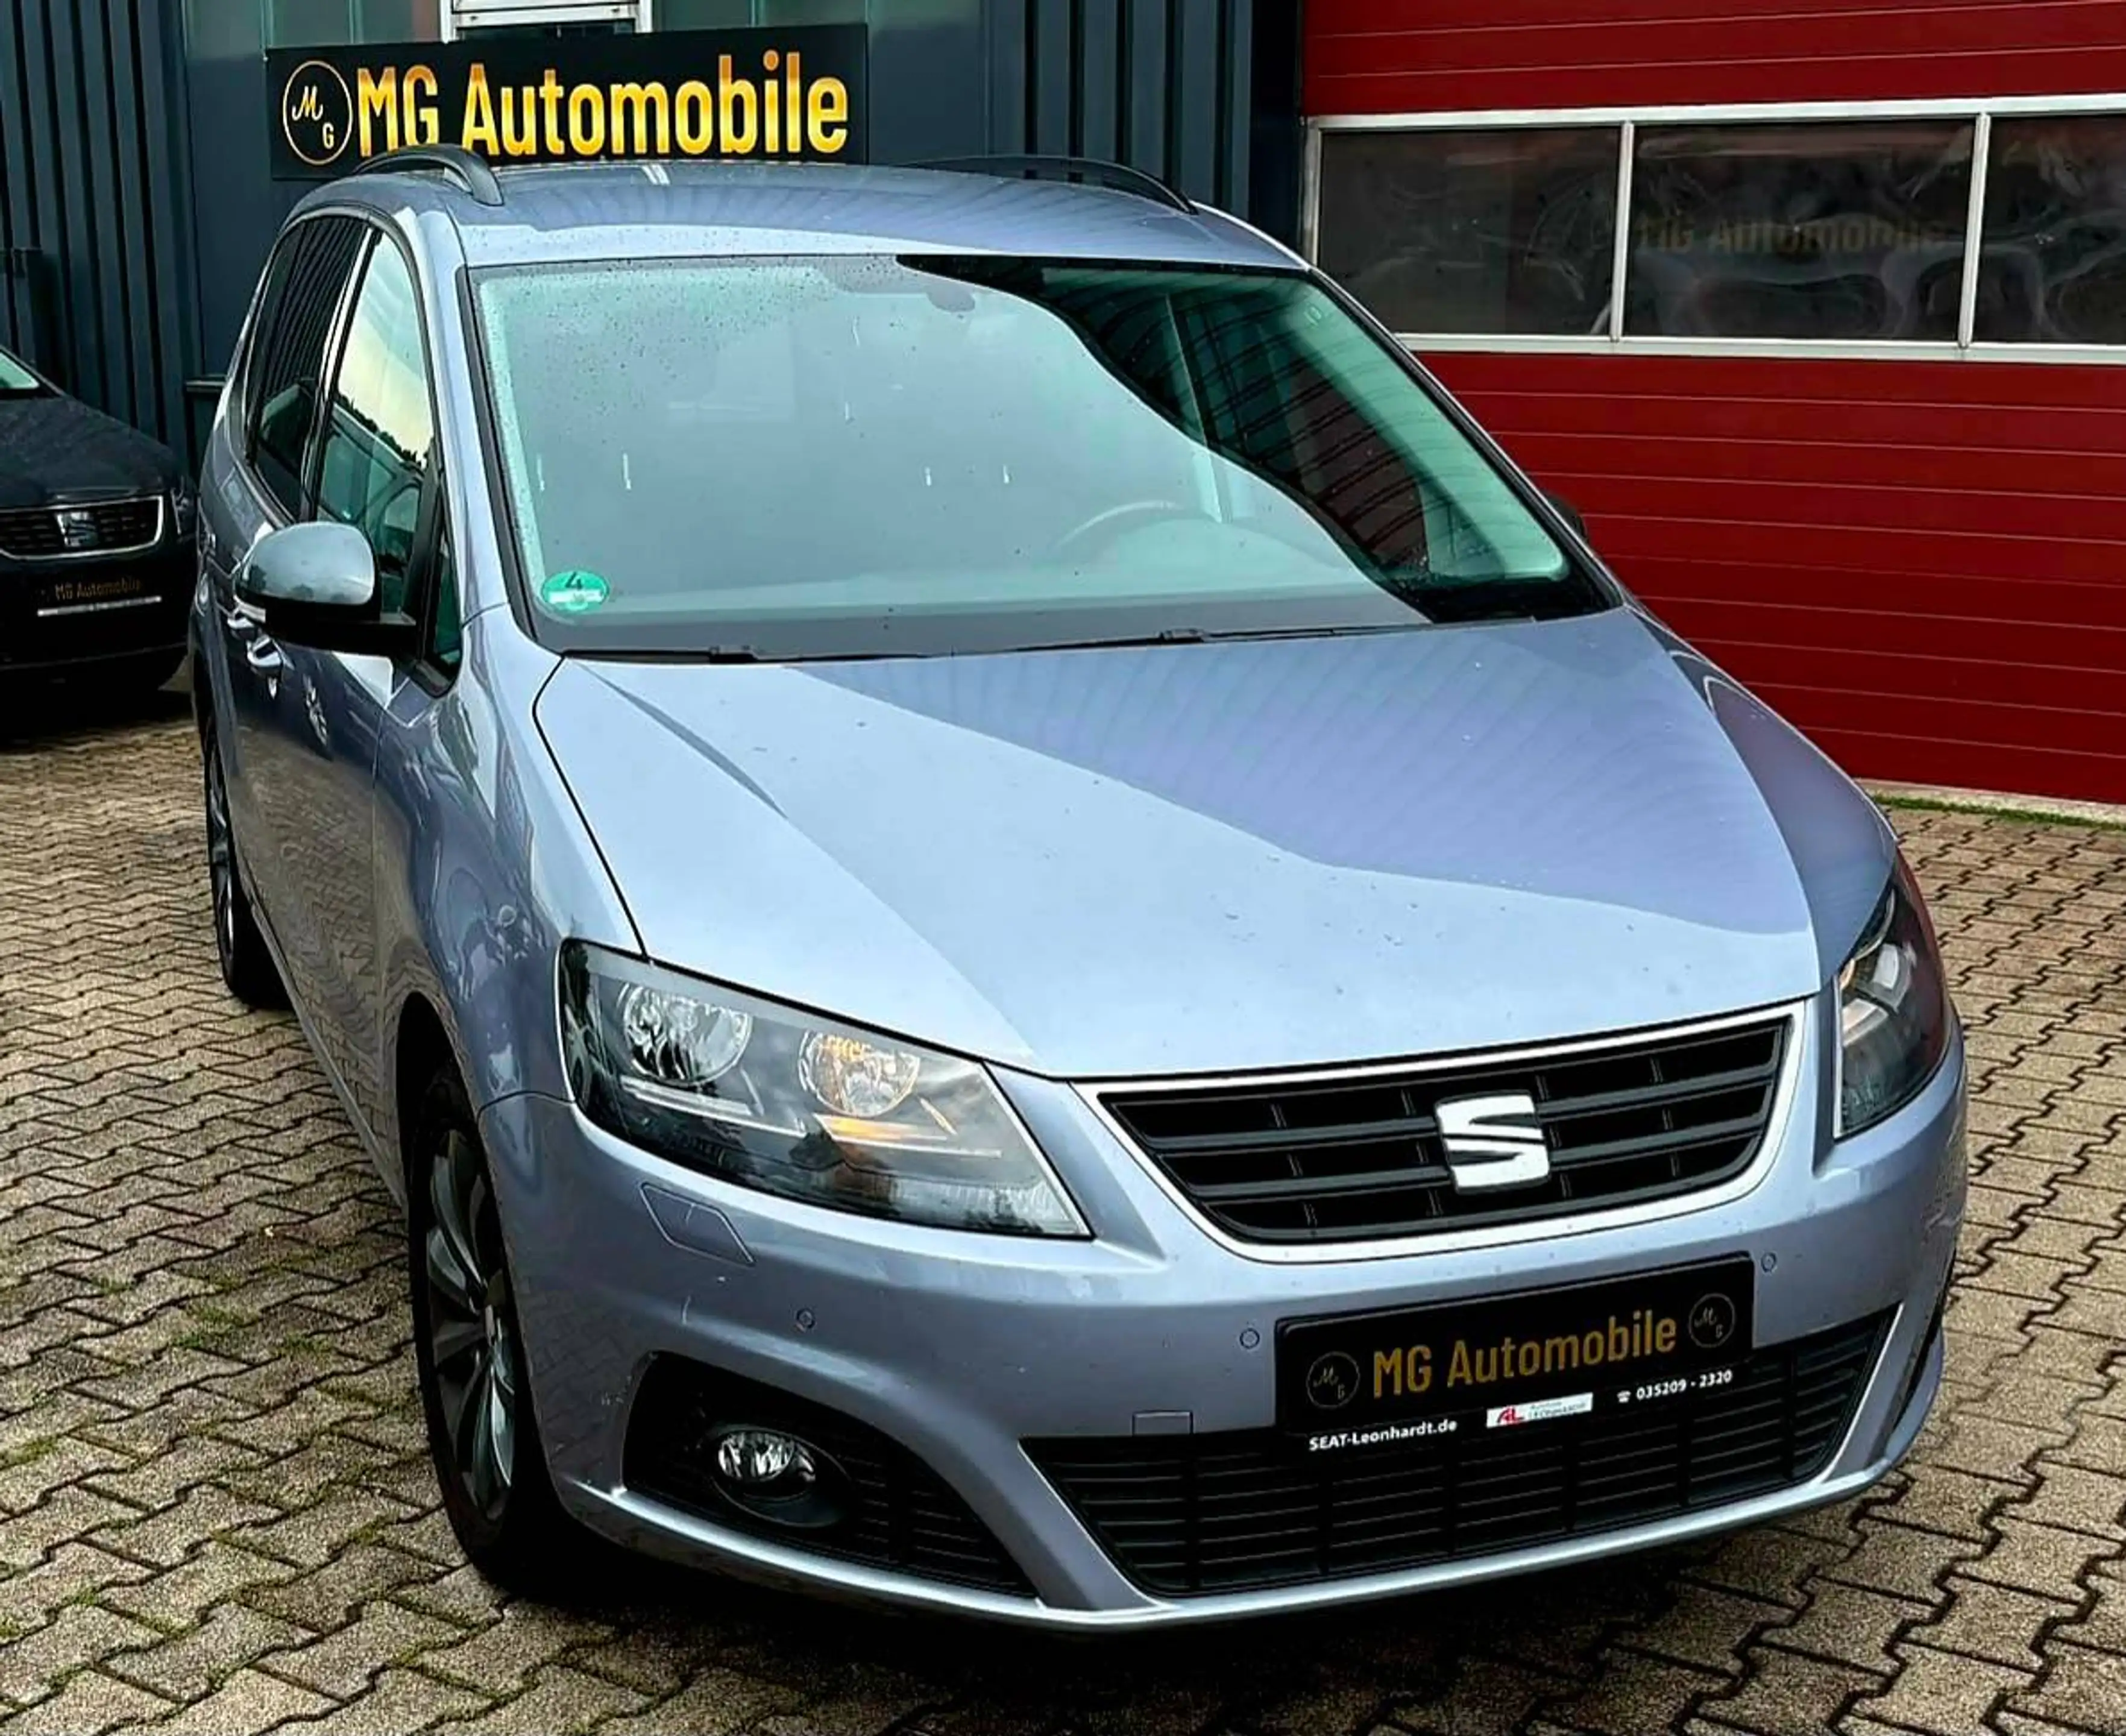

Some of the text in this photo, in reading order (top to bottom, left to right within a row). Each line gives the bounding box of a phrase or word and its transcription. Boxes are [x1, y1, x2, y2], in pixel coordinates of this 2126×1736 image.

[357, 51, 848, 157] MG Automobile
[564, 571, 583, 591] 4
[1374, 1310, 1677, 1398] MG Automobile
[1636, 1379, 1687, 1400] 035209
[1699, 1369, 1733, 1387] 2320
[1309, 1418, 1458, 1451] SEAT-Leonhardt.de
